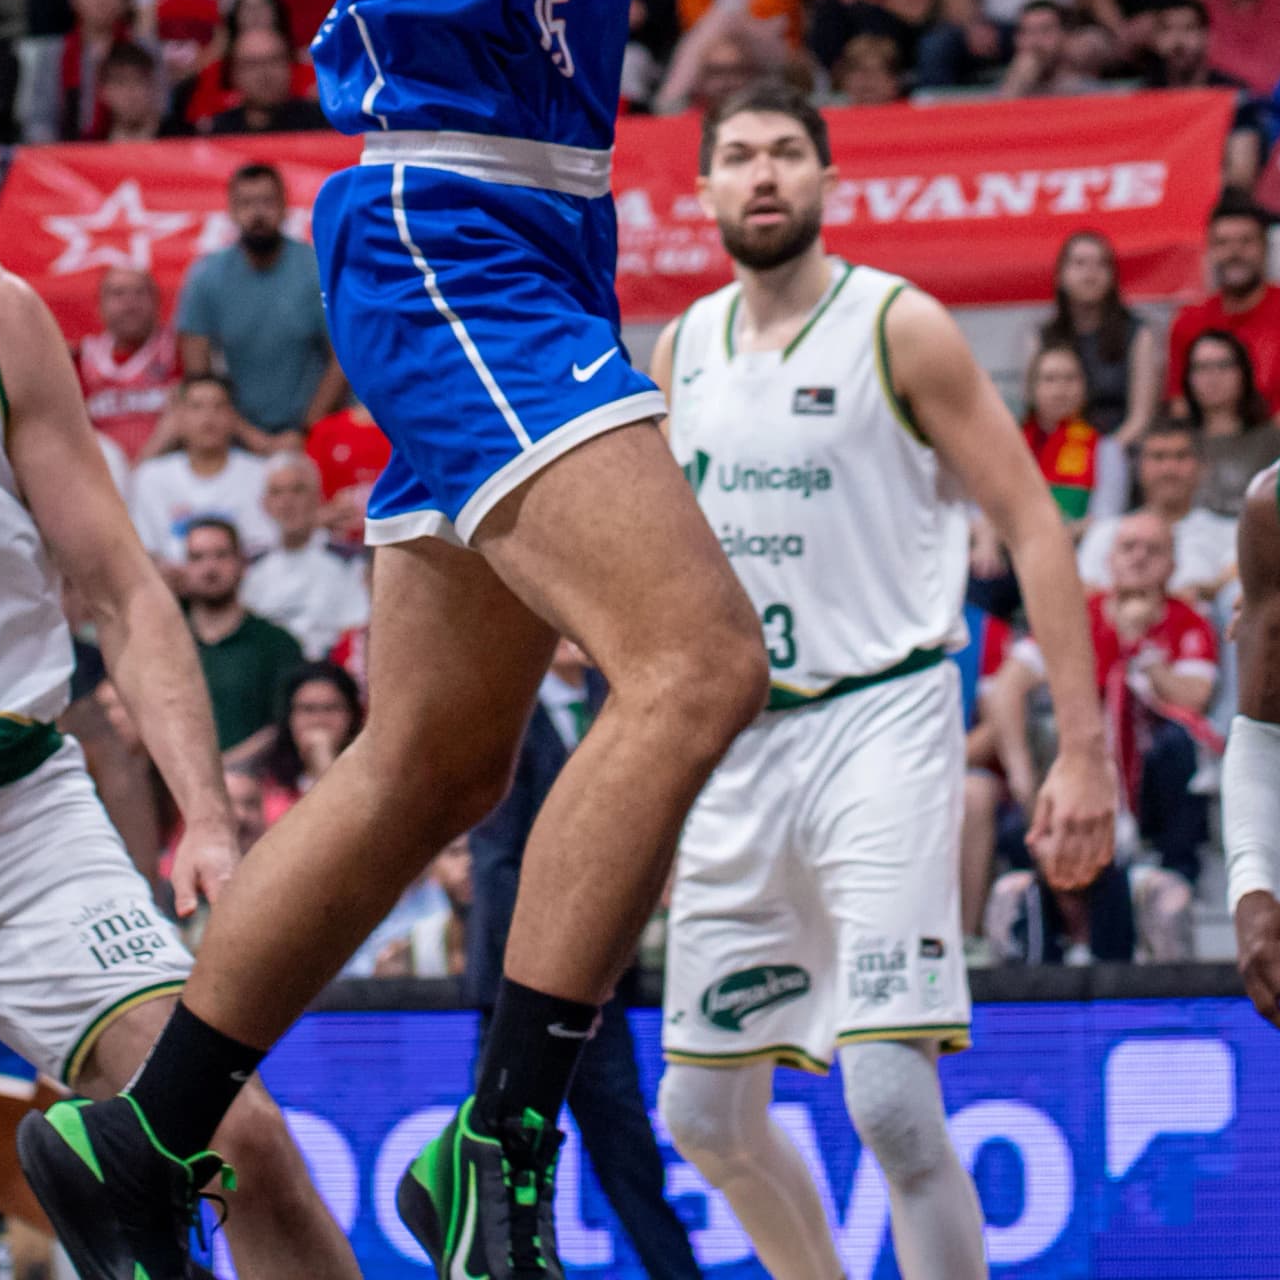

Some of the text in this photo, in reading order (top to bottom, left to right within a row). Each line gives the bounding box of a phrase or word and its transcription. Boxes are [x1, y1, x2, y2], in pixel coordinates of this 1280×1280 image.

[824, 162, 1170, 226] EVANTE
[718, 458, 834, 498] Unicaja
[720, 523, 806, 565] álaga
[762, 602, 798, 670] 3
[89, 931, 168, 970] laga
